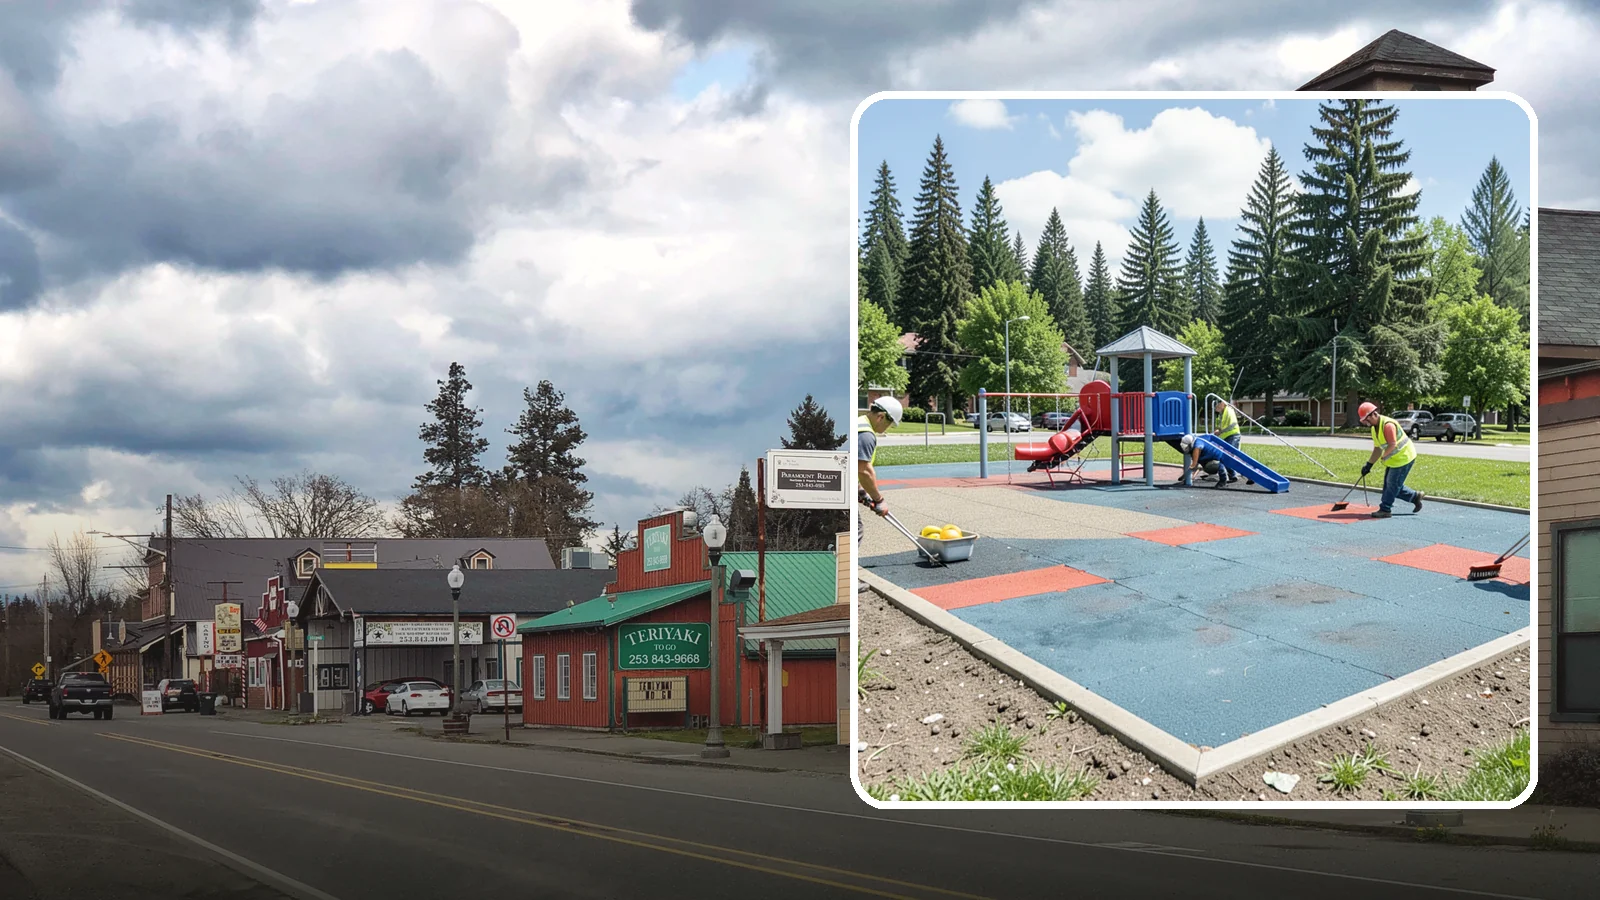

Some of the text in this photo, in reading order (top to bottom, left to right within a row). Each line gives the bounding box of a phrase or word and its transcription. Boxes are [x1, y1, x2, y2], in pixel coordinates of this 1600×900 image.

[624, 628, 702, 646] TERIYAKI
[629, 654, 700, 664] 253 843-9668
